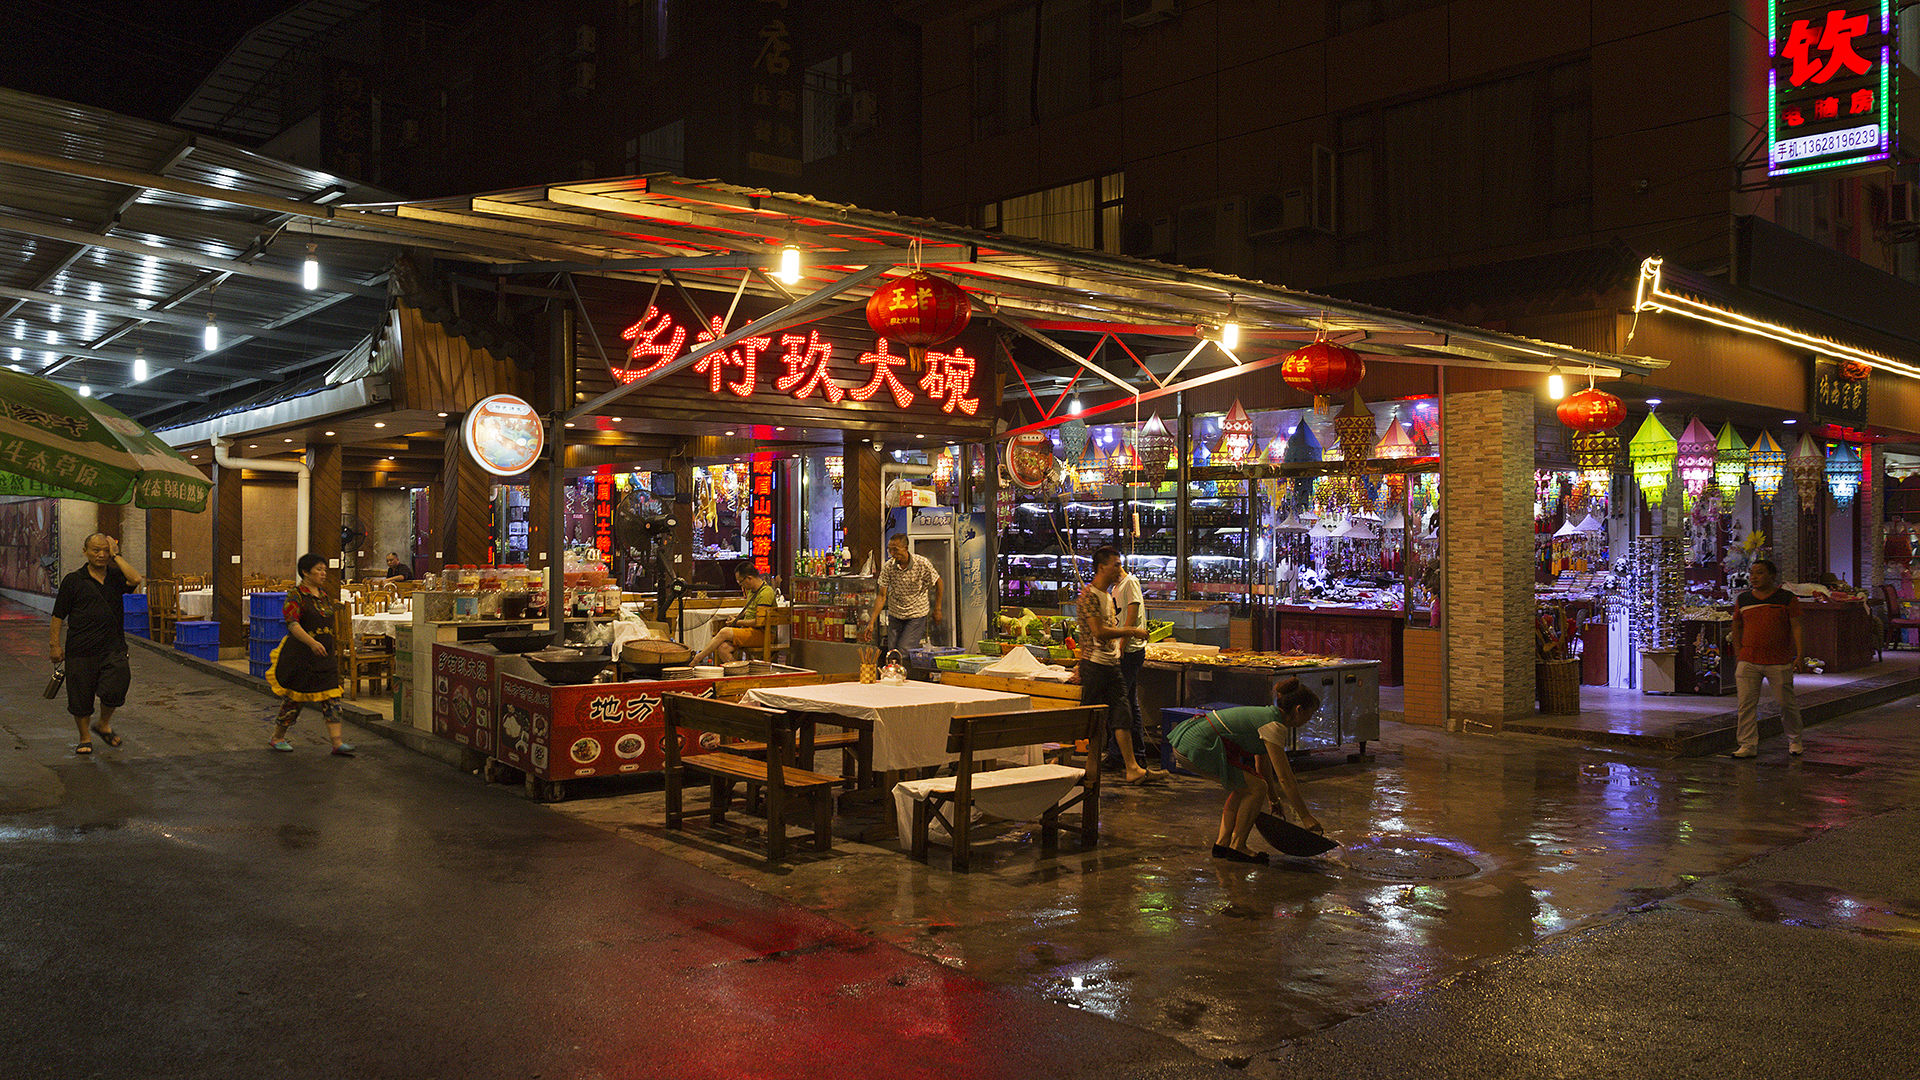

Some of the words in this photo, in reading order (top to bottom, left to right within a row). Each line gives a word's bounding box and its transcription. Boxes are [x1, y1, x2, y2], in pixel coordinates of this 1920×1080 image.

[1781, 10, 1873, 87] 饮
[1782, 88, 1874, 127] 电脑房
[1777, 128, 1876, 161] 手机:13628196239
[888, 286, 953, 311] 王老吉
[612, 305, 980, 416] 乡村玖大碗
[0, 438, 101, 487] 生态草原
[438, 651, 488, 682] 乡村玖大碗
